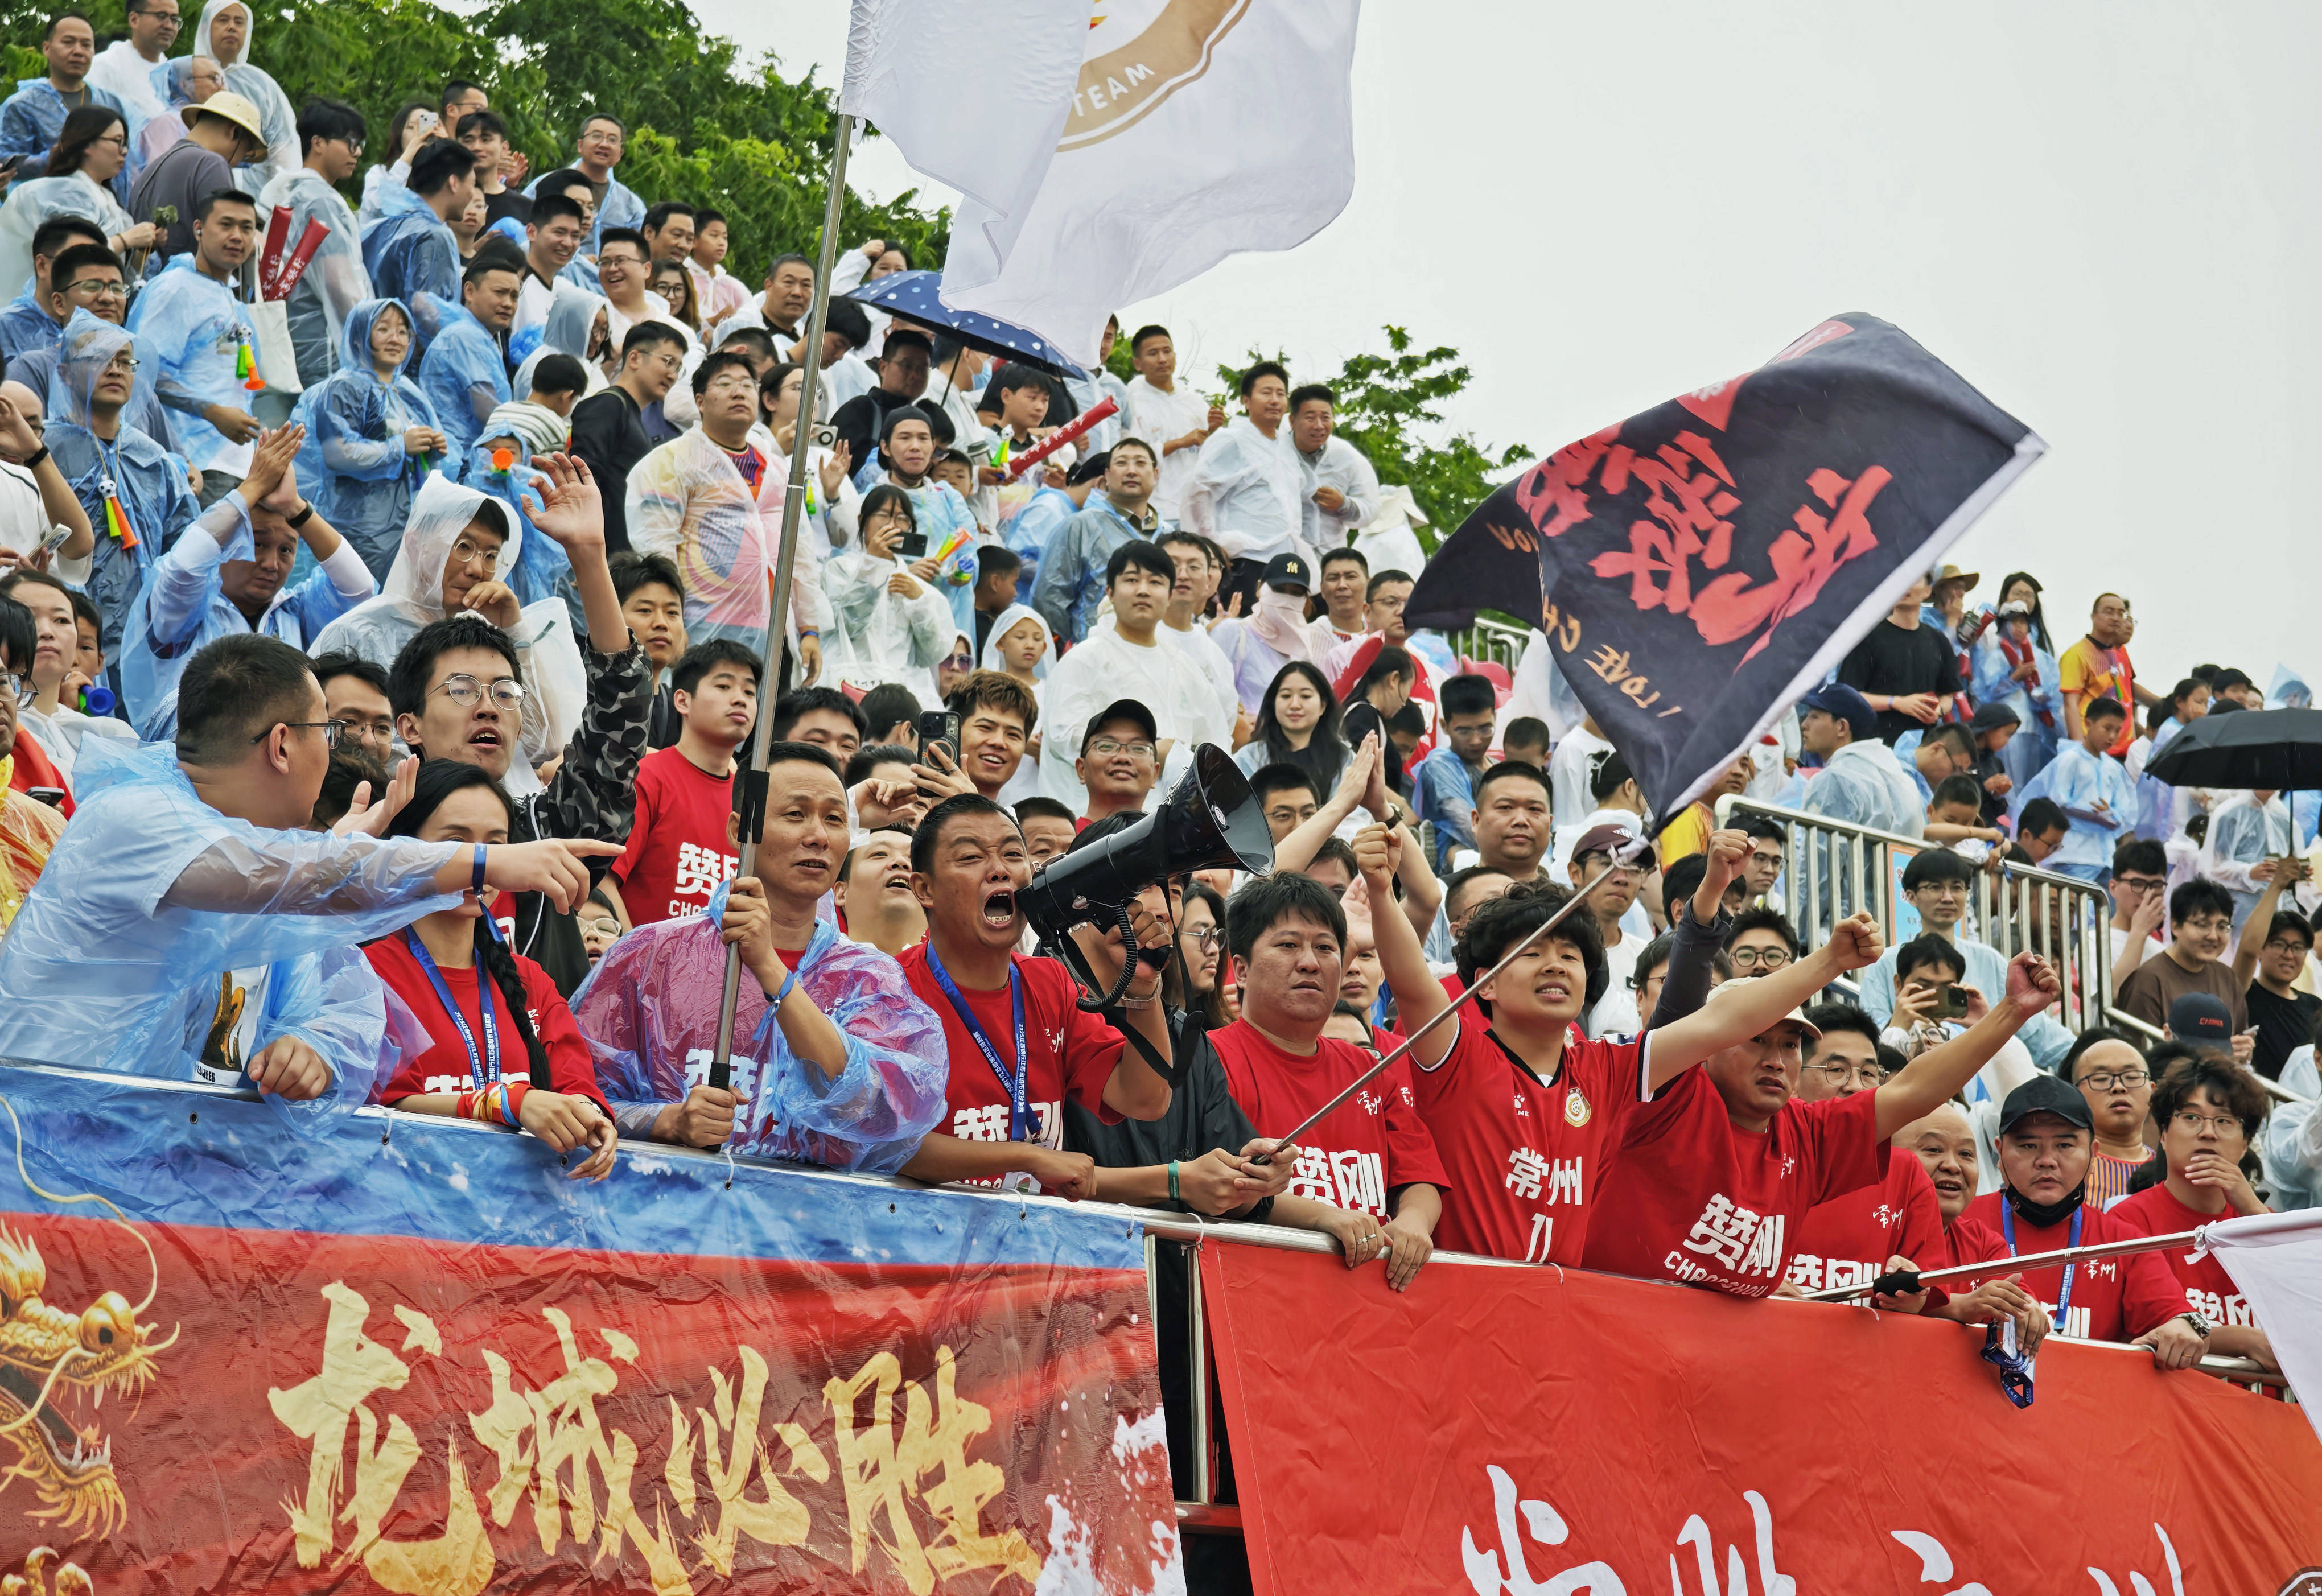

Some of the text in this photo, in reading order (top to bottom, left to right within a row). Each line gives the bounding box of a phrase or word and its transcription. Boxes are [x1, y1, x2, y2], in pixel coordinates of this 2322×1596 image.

[1072, 63, 1155, 117] TEAM
[1505, 1147, 1583, 1206] 常州
[1525, 1213, 1553, 1263] 11
[1682, 1192, 1785, 1279] 赞刚
[1872, 1204, 1903, 1230] 常州
[2084, 1259, 2117, 1283] 常州
[267, 1279, 1041, 1596] 龙城必胜
